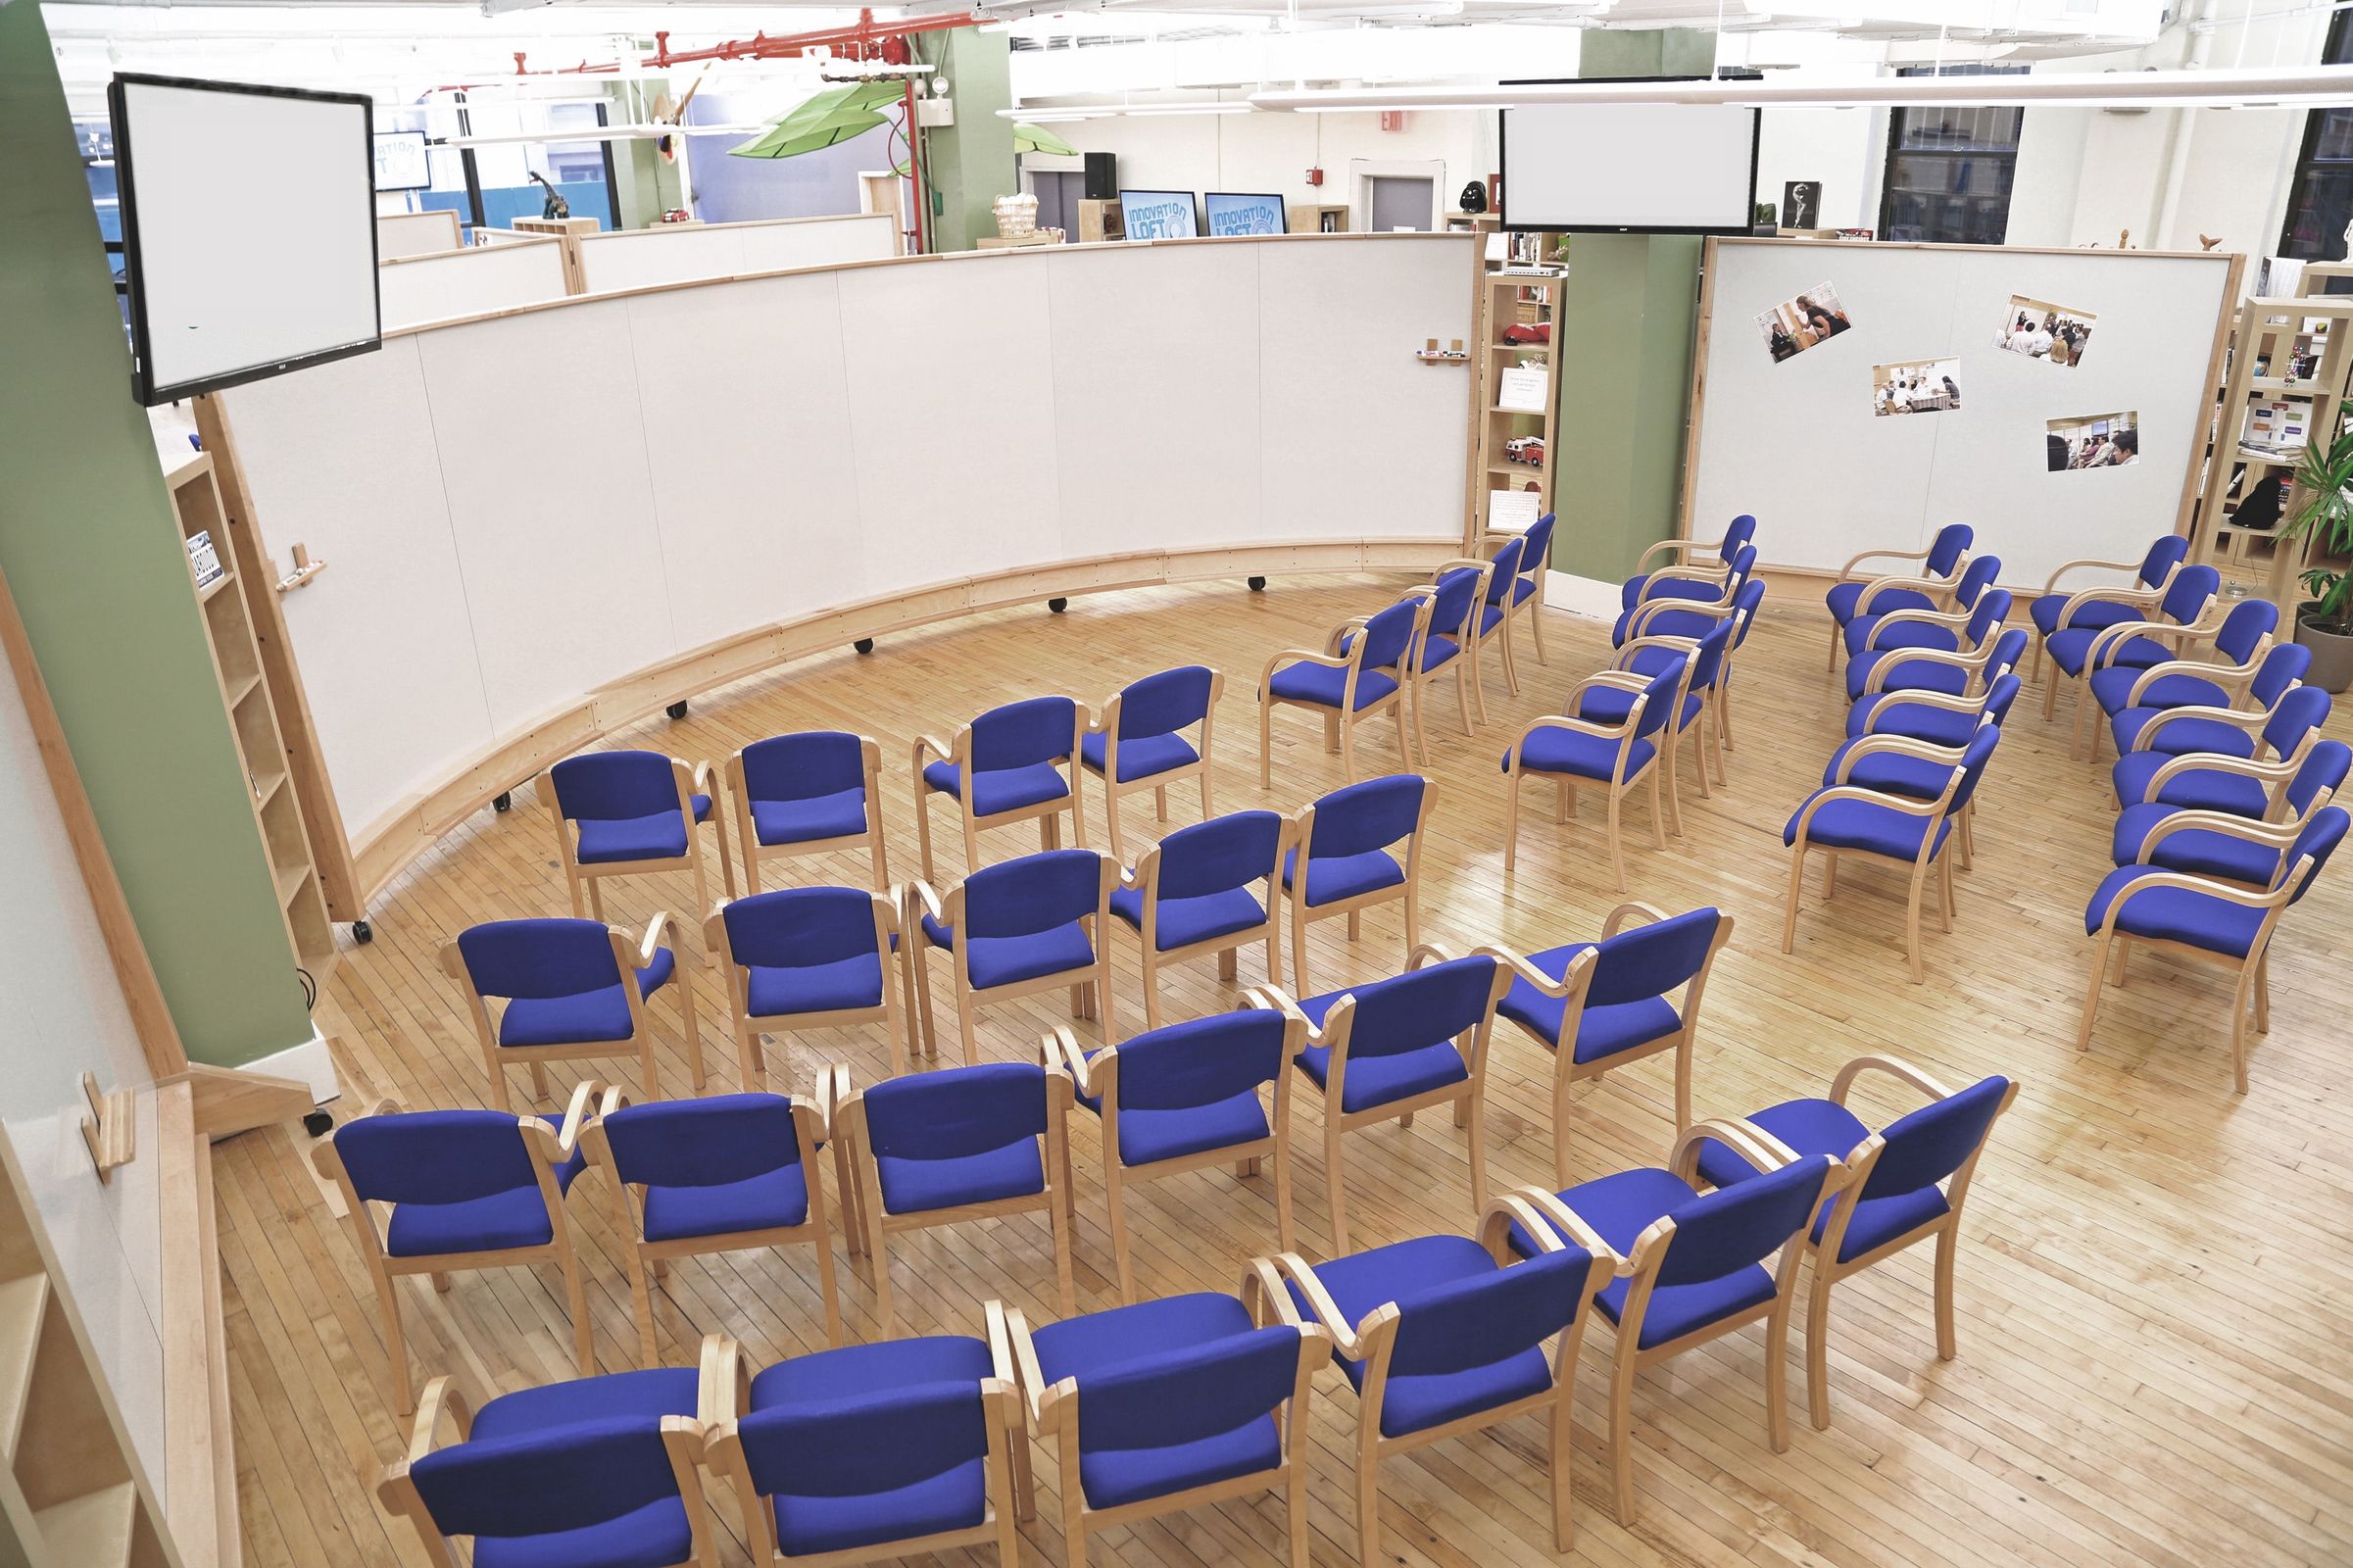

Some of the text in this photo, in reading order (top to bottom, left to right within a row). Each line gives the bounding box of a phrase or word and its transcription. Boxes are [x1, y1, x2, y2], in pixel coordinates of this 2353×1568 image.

[1382, 110, 1402, 131] EXIT
[377, 141, 416, 157] ATION
[1128, 202, 1187, 222] INNOVATION
[1213, 206, 1275, 227] INNOVATION
[1131, 219, 1165, 240] LOFT
